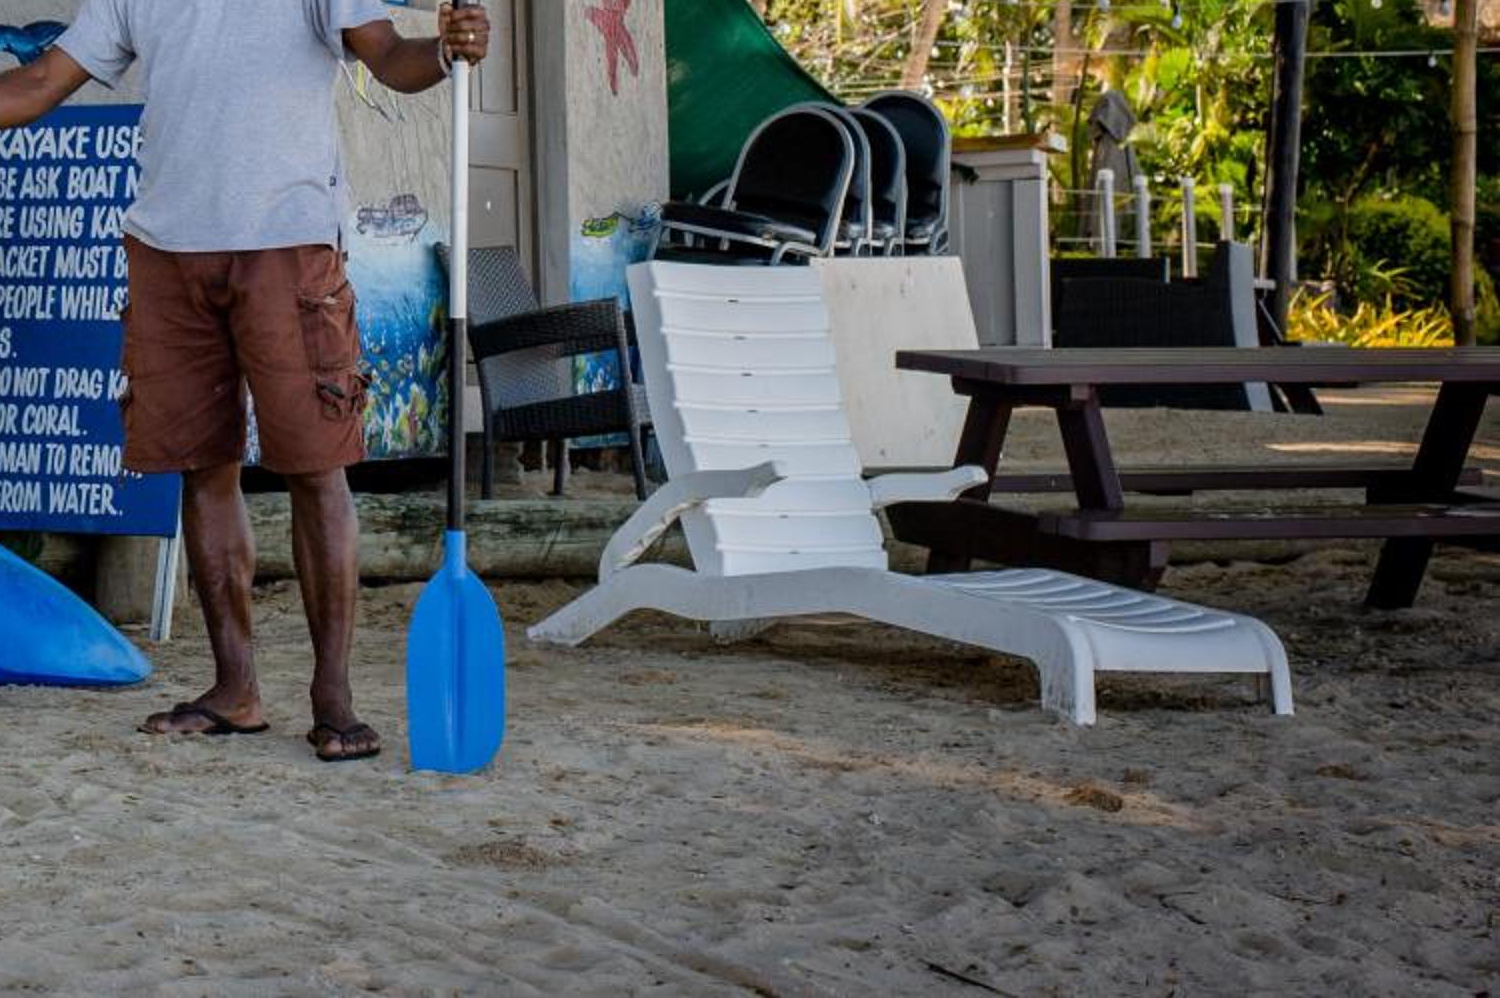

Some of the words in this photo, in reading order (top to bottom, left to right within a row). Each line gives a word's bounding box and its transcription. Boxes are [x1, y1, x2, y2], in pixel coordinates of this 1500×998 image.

[95, 125, 143, 159] USE
[20, 166, 61, 199] ASK
[66, 166, 122, 200] BOAT
[19, 205, 84, 239] USING
[53, 245, 112, 279] MUST
[60, 285, 129, 321] WHILS
[53, 367, 104, 400] DRAG
[21, 404, 88, 436] CORAL.
[46, 442, 67, 475] TO
[69, 443, 143, 479] REMO
[49, 482, 123, 517] WATER.
